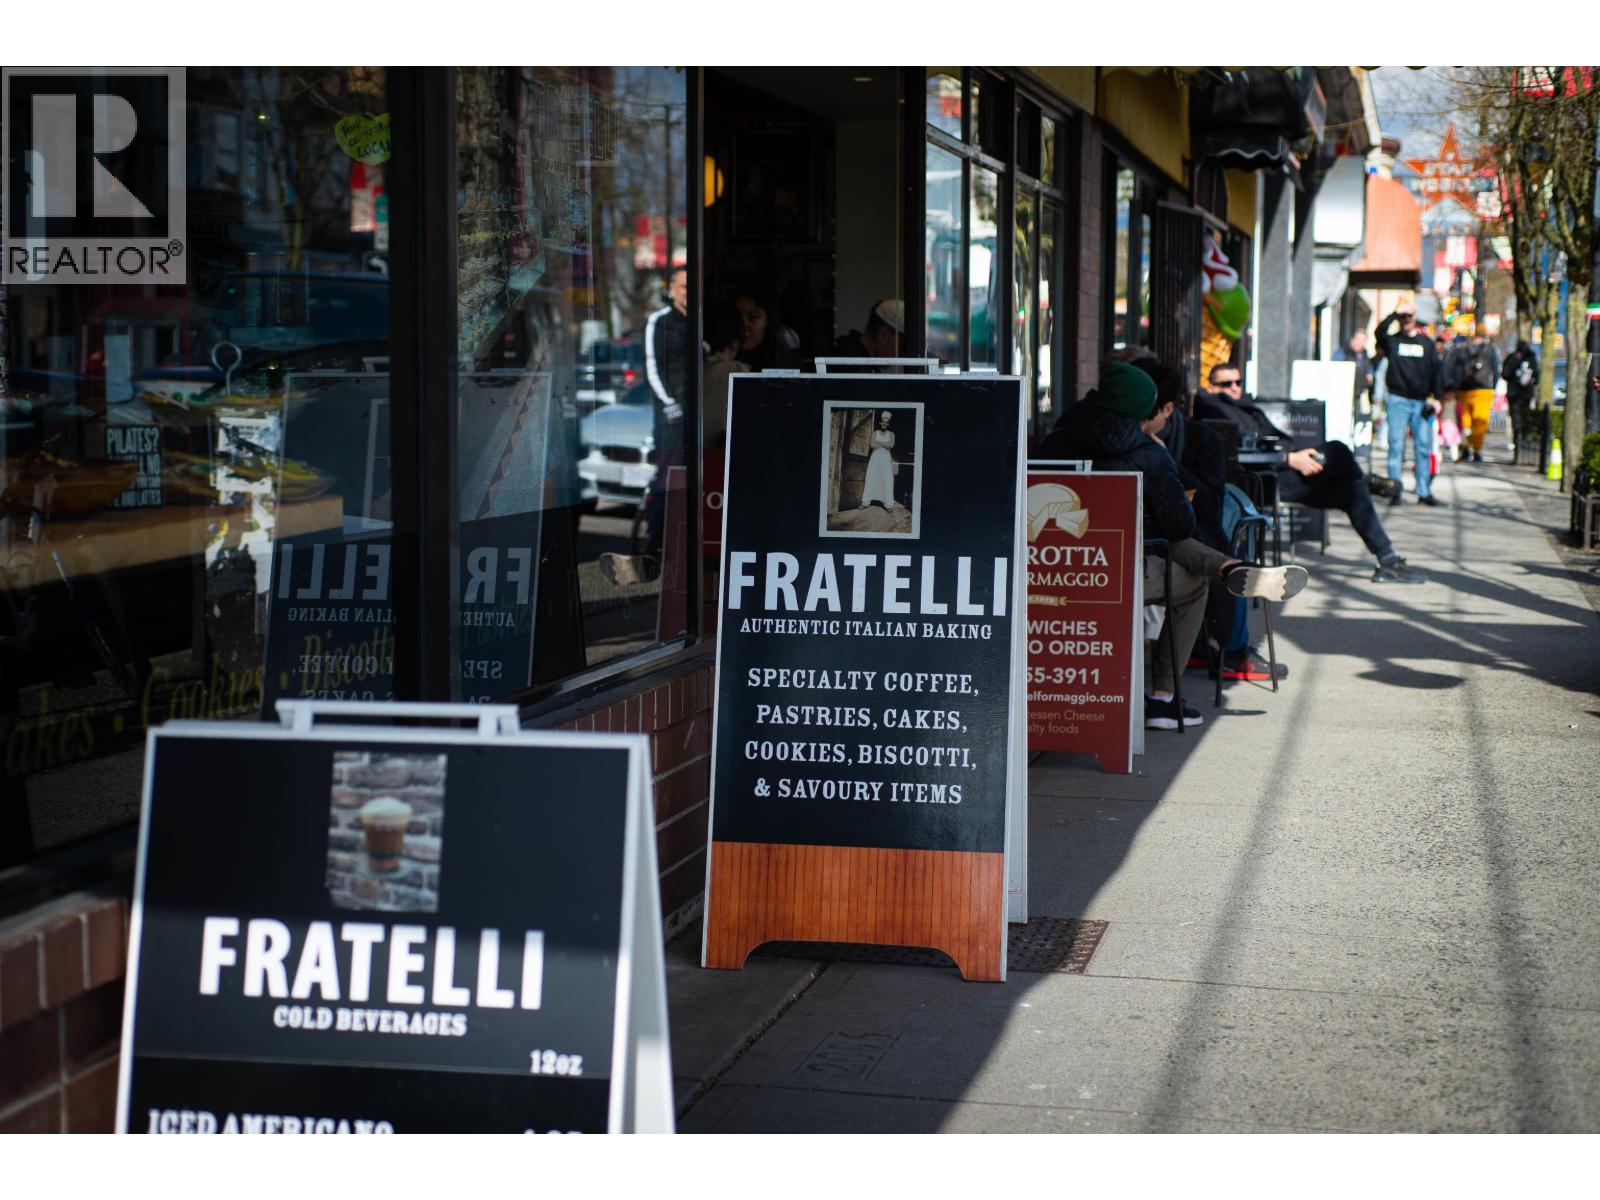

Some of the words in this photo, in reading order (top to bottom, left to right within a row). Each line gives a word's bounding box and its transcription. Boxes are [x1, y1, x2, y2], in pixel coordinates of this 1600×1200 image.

[106, 427, 160, 454] PILATES?
[1027, 546, 1109, 566] ROTTA
[728, 551, 1008, 616] FRATELLI
[1027, 572, 1109, 587] RMAGGIO
[740, 617, 840, 635] AUTHENTIC
[844, 620, 917, 637] ITALIAN
[922, 623, 992, 640] BAKING
[1027, 620, 1098, 636] WICHES
[1027, 640, 1043, 654] O
[1048, 640, 1114, 656] ORDER
[748, 668, 877, 691] SPECIALTY
[883, 672, 979, 696] COFFEE,
[756, 704, 878, 730] PASTRIES,
[883, 709, 968, 733] CAKES,
[1048, 722, 1079, 734] foods
[1064, 710, 1105, 722] Cheese
[745, 741, 853, 766] COOKIES,
[857, 744, 977, 770] BISCOTTI,
[753, 778, 771, 797] &
[778, 778, 884, 801] SAVOURY
[890, 782, 963, 805] ITEMS
[200, 916, 545, 1010] FRATELLI
[273, 1004, 333, 1030] COLD
[335, 1007, 467, 1037] BEVERAGES
[529, 1048, 583, 1076] 12oz
[148, 1108, 218, 1134] ICED
